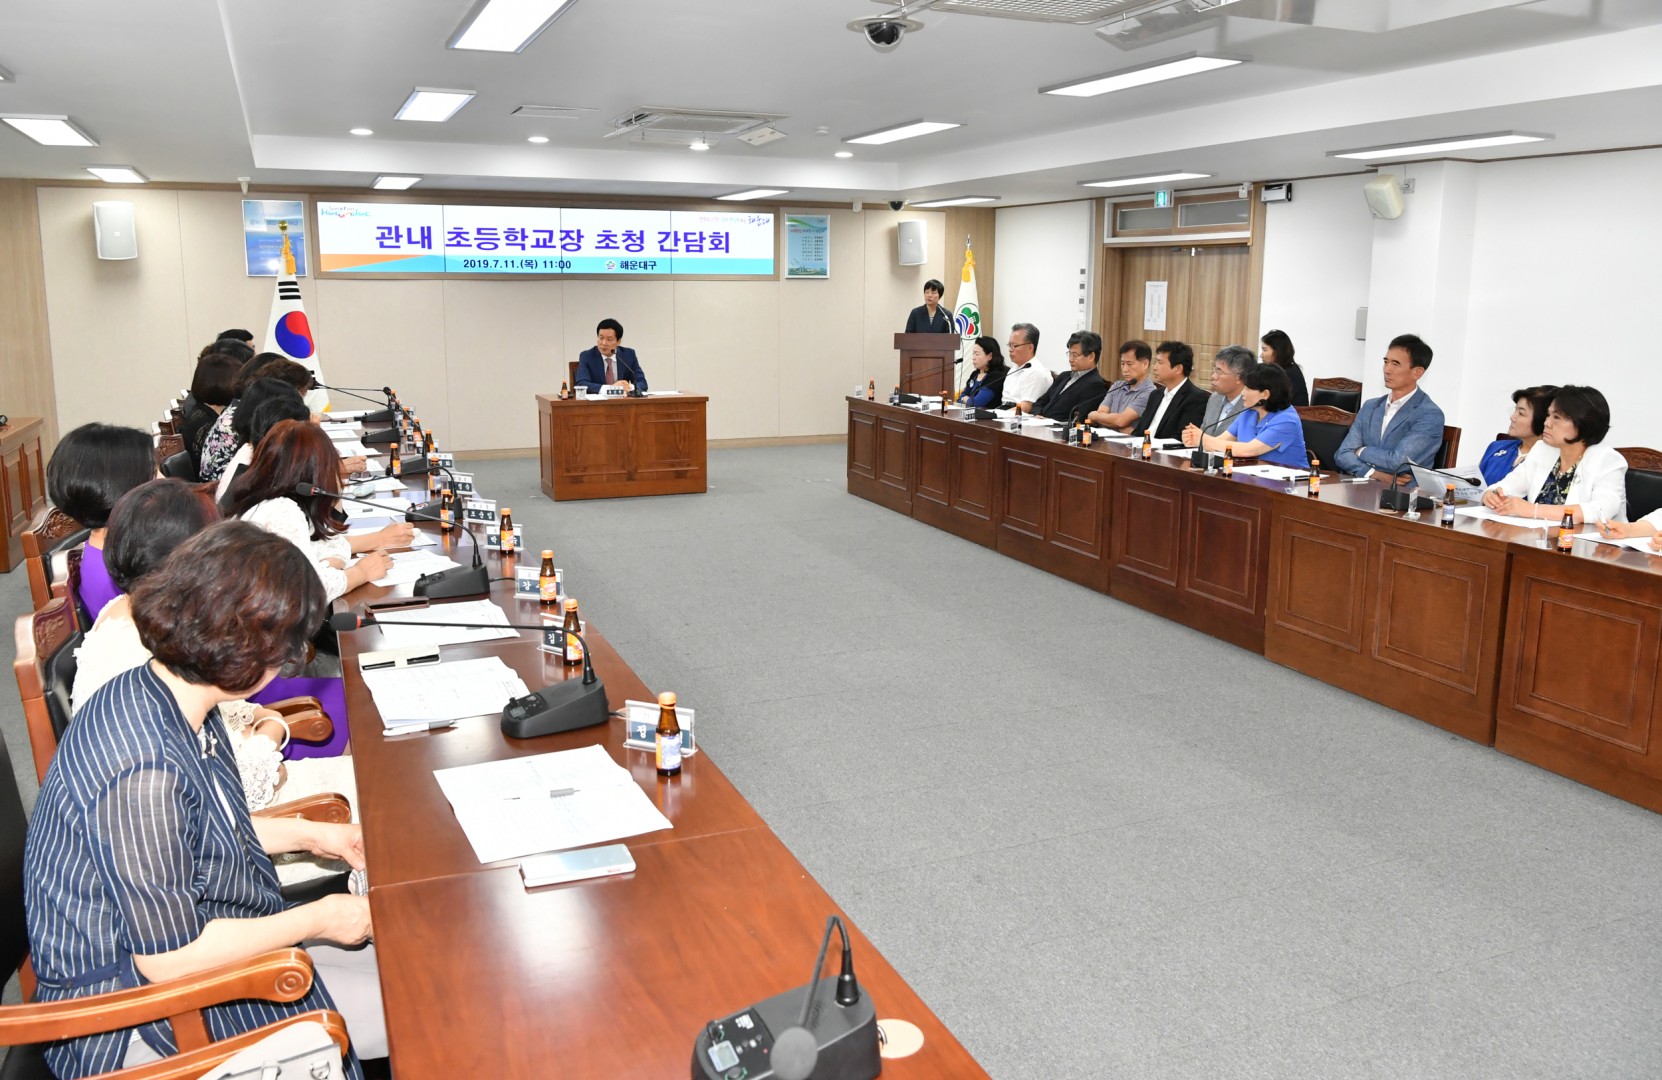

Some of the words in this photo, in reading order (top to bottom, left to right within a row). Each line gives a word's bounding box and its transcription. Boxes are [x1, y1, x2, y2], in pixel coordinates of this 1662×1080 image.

[375, 225, 433, 250] 관내
[445, 226, 585, 252] 초등학교장
[594, 229, 645, 253] 초청
[657, 230, 730, 254] 간담회
[463, 259, 538, 270] 2019.7.11.(목)
[543, 260, 572, 270] 11:00
[619, 260, 657, 271] 해운대구
